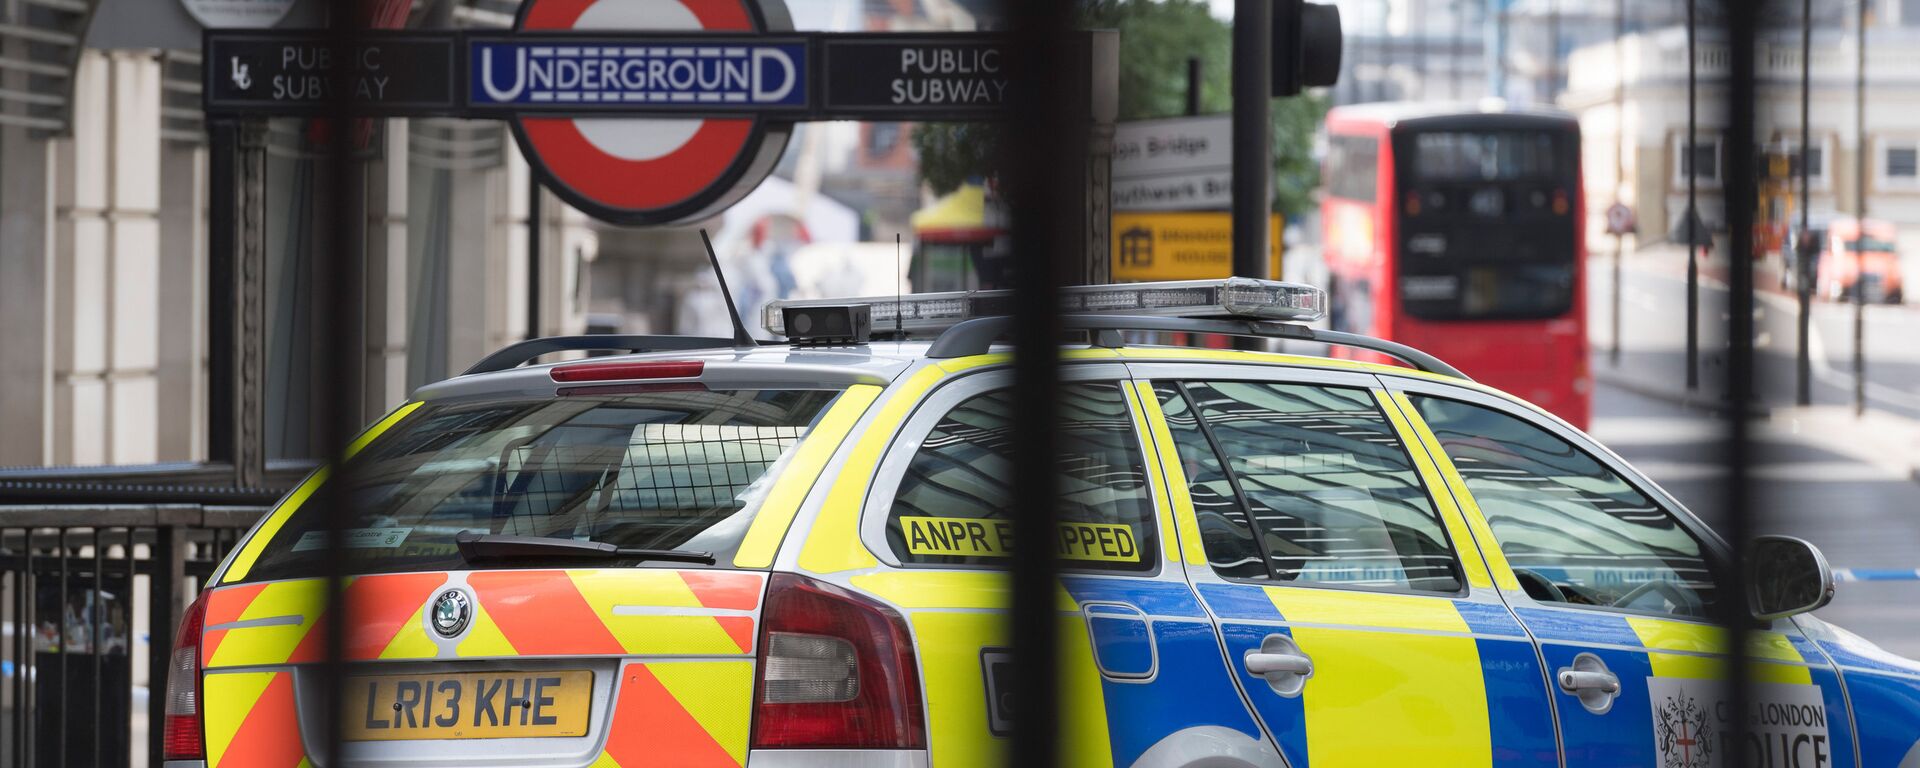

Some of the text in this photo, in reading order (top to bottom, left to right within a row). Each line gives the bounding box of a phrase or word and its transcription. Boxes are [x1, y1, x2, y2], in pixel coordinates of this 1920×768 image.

[282, 45, 381, 70] PUBIC
[901, 48, 1000, 73] PUBLIC
[272, 74, 389, 100] SUBAY
[482, 47, 796, 102] UNDERGROUND
[891, 78, 1008, 103] SUBWAY
[1147, 135, 1207, 157] Bridge
[911, 520, 1134, 558] ANPR EIPPED
[365, 677, 562, 729] LR13 KHE
[1759, 702, 1825, 727] LONDON
